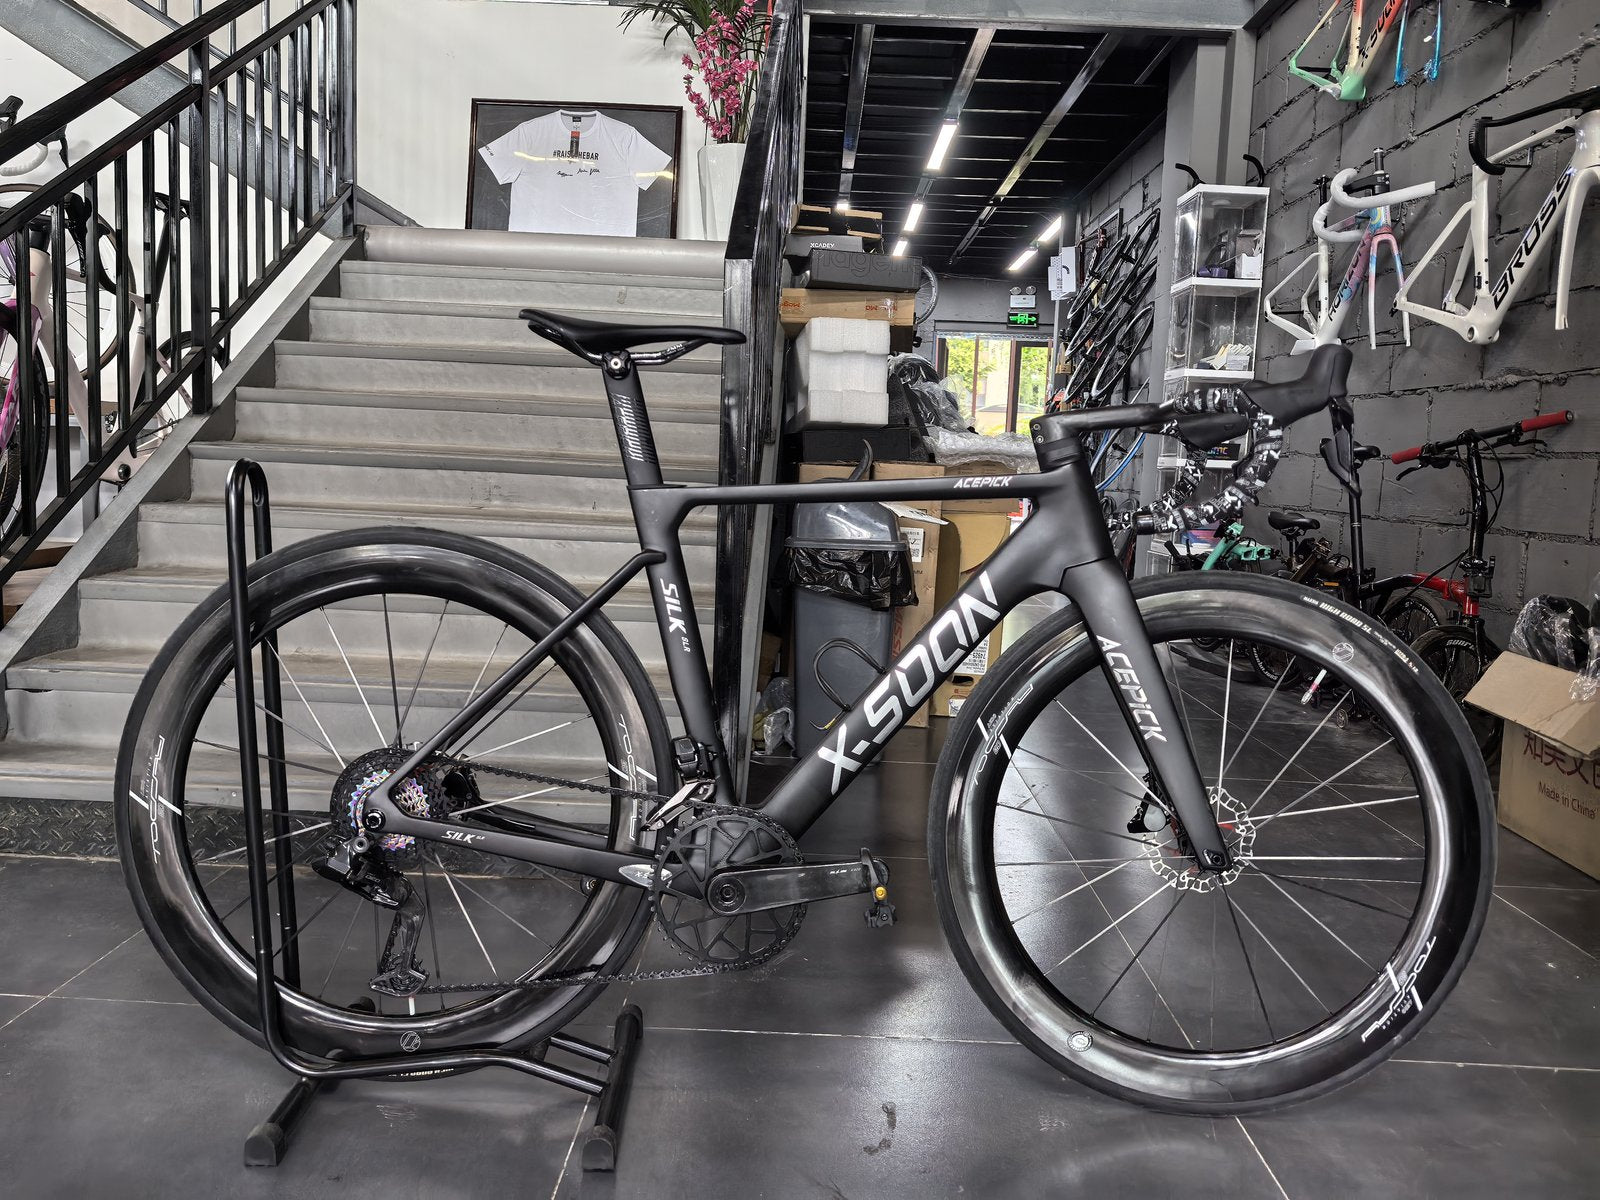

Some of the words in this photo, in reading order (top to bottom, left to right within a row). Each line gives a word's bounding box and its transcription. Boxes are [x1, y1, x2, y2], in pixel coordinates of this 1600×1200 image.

[552, 149, 600, 161] #RAISHEBAR
[659, 578, 688, 634] SILK
[1570, 797, 1597, 820] China
[440, 830, 477, 844] SILK
